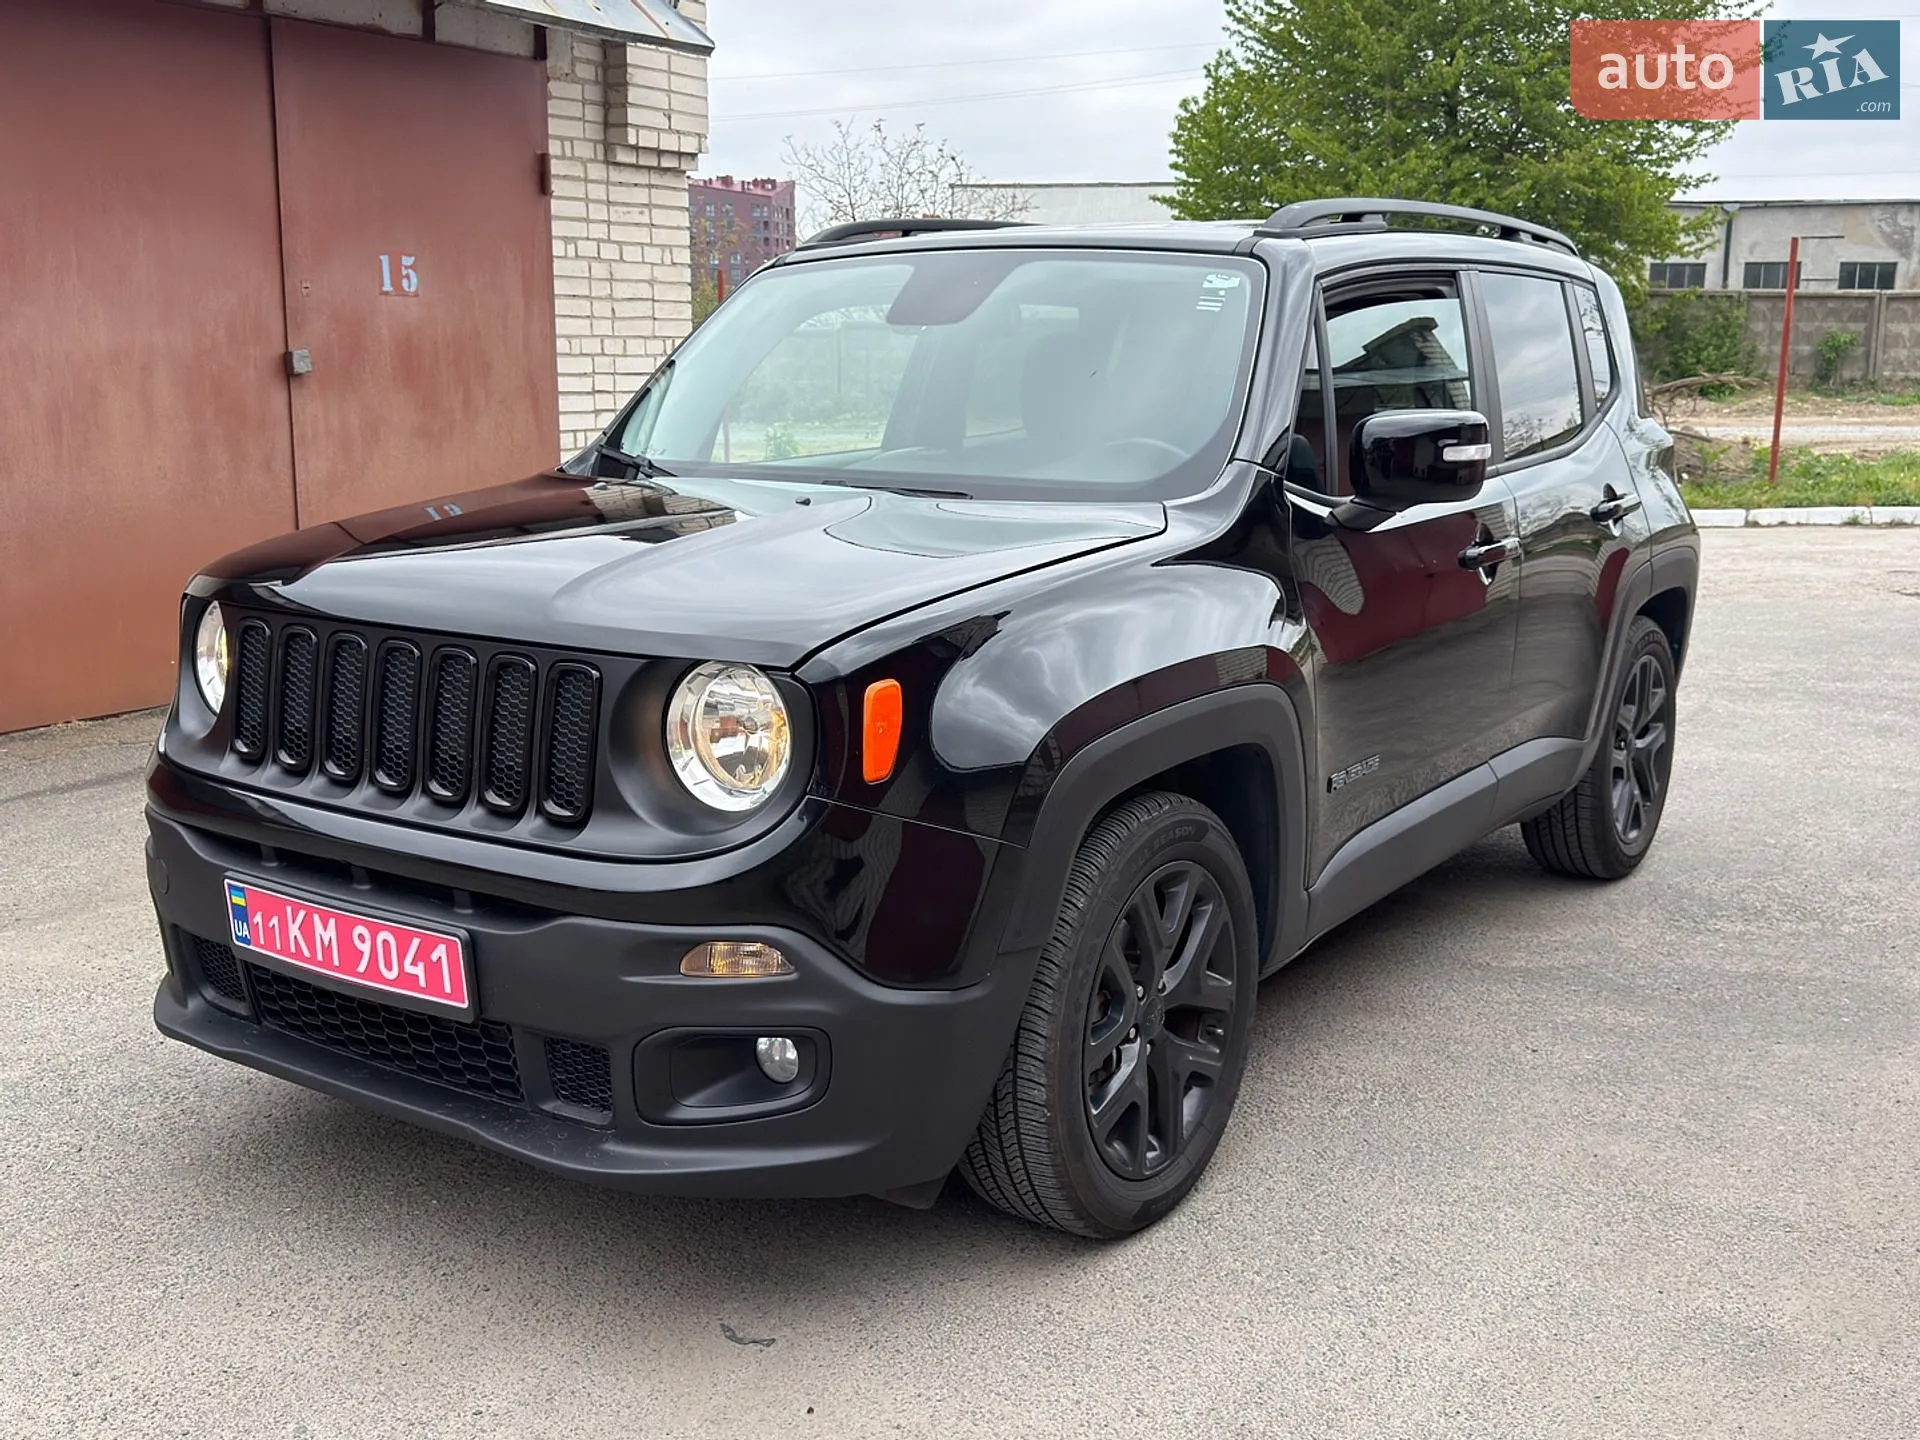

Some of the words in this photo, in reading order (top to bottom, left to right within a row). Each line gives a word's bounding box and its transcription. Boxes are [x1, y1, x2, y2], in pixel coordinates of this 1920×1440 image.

[379, 254, 418, 292] 15
[234, 920, 250, 940] UA
[352, 925, 452, 994] 9041
